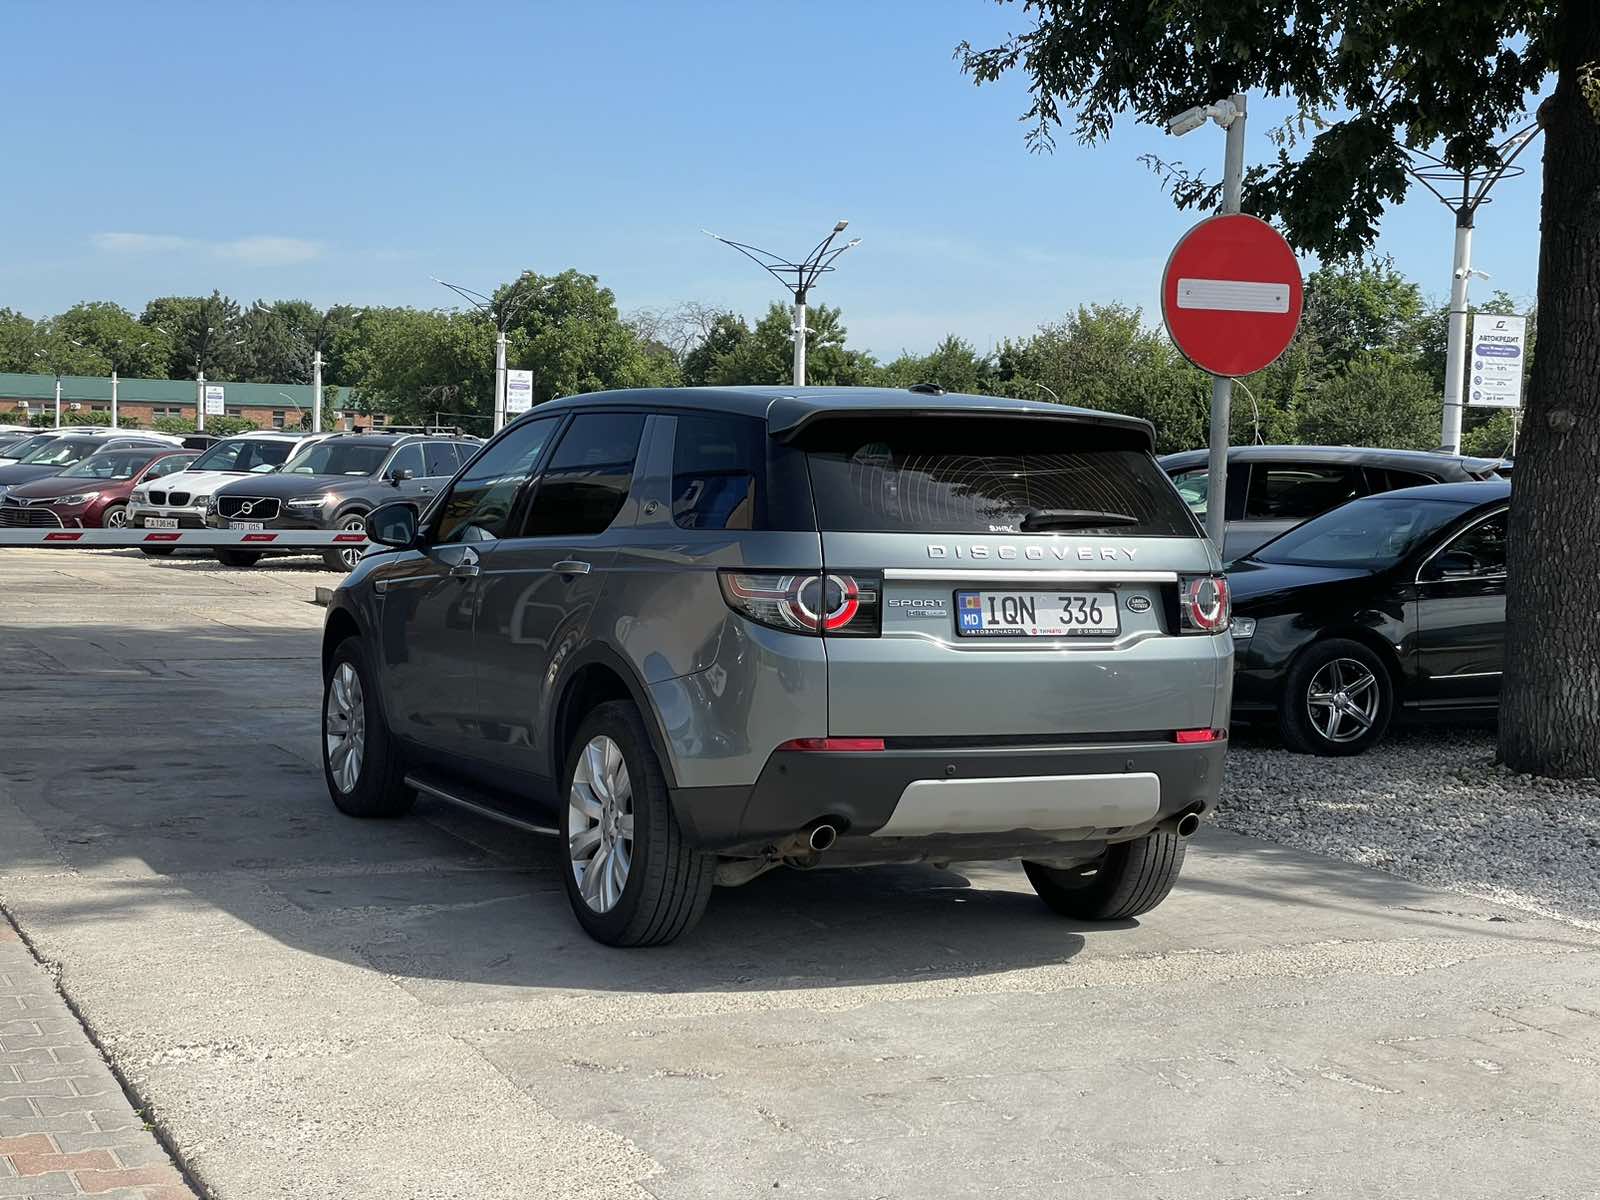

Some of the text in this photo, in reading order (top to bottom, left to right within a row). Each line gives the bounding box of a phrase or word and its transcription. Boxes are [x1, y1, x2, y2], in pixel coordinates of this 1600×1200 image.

[1479, 335, 1519, 343] АВТОКРЕДИТ
[927, 544, 1137, 561] DISCOVERY
[888, 599, 946, 607] SPORT
[987, 596, 1103, 625] IQN 336
[963, 613, 979, 625] MD
